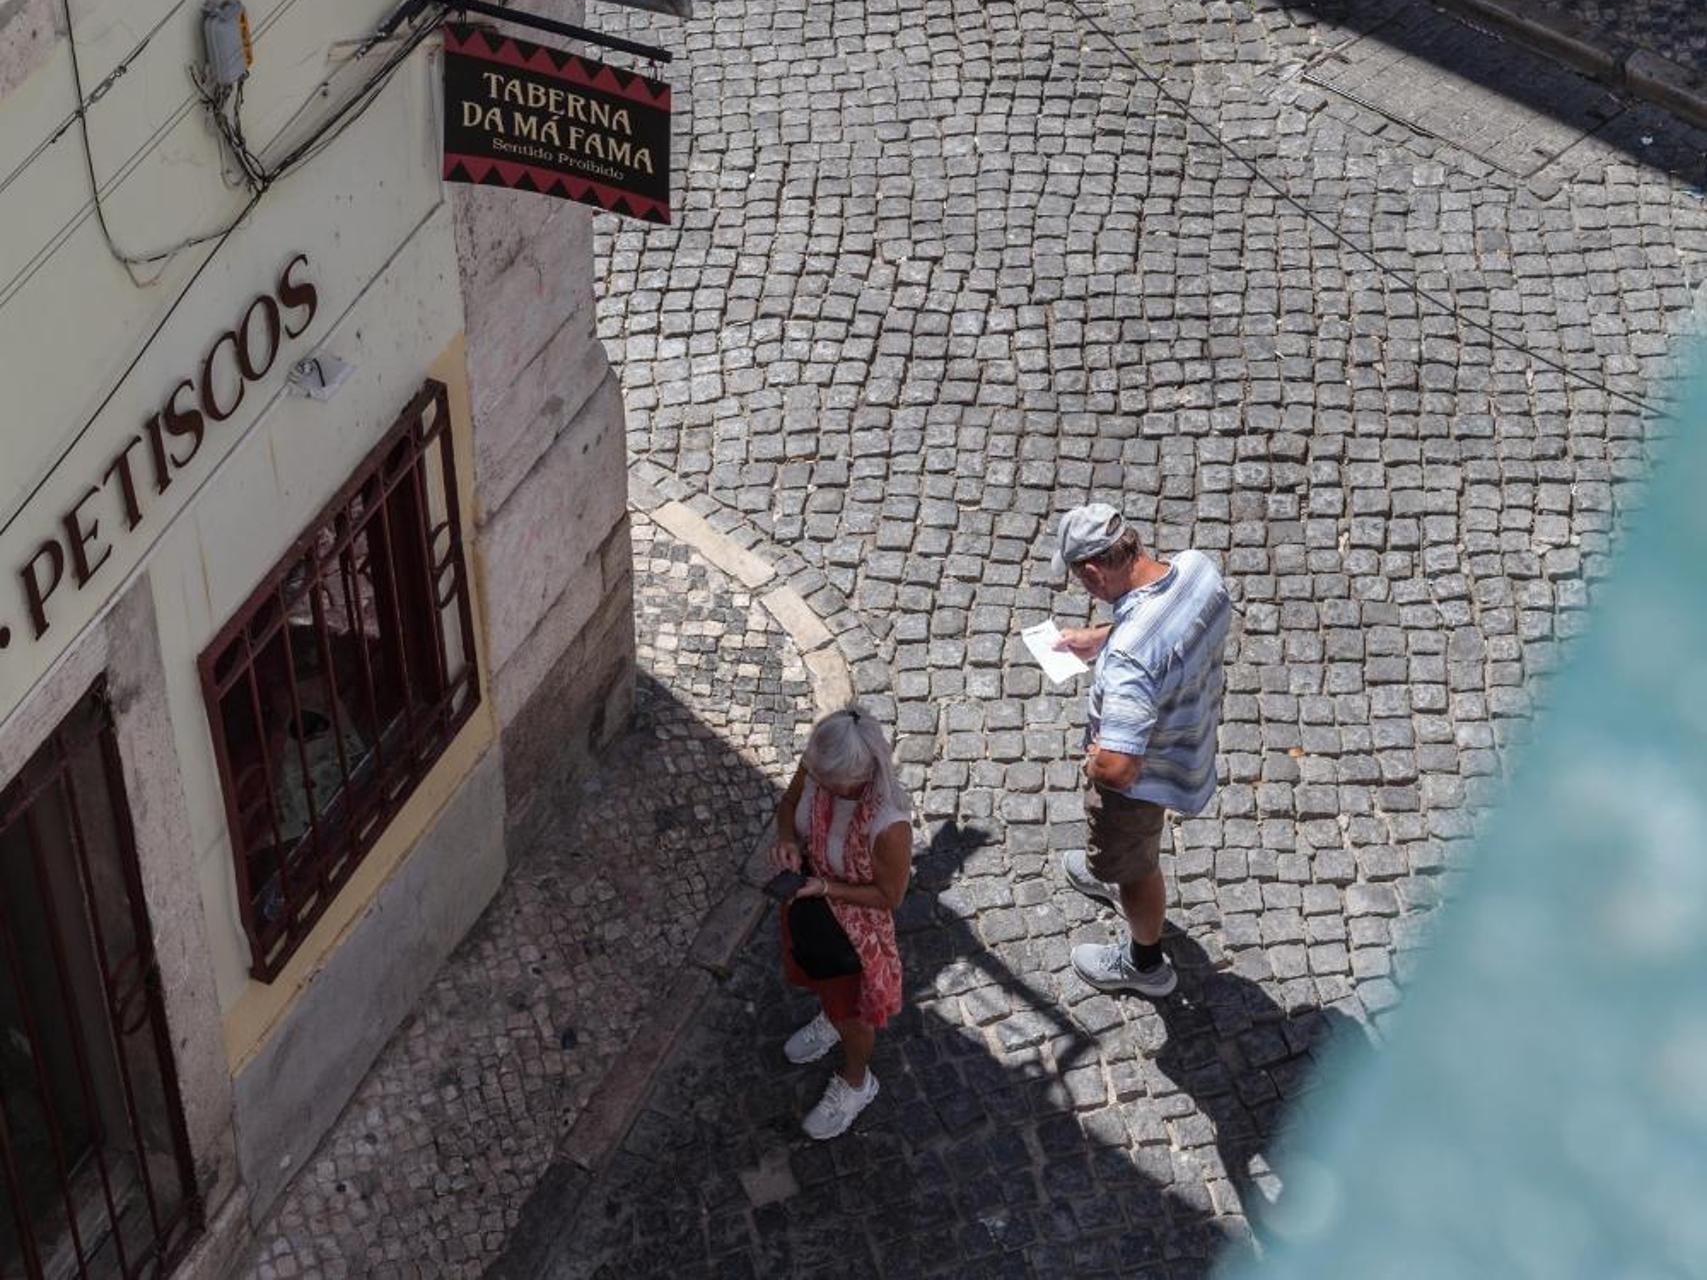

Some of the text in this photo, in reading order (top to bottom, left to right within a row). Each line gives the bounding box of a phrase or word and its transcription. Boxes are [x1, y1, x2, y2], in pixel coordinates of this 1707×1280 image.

[461, 101, 654, 175] DA MÁ FAMA
[482, 71, 633, 136] TABERNA
[492, 137, 625, 181] Sentido Proibido
[19, 254, 319, 641] PETISCOS
